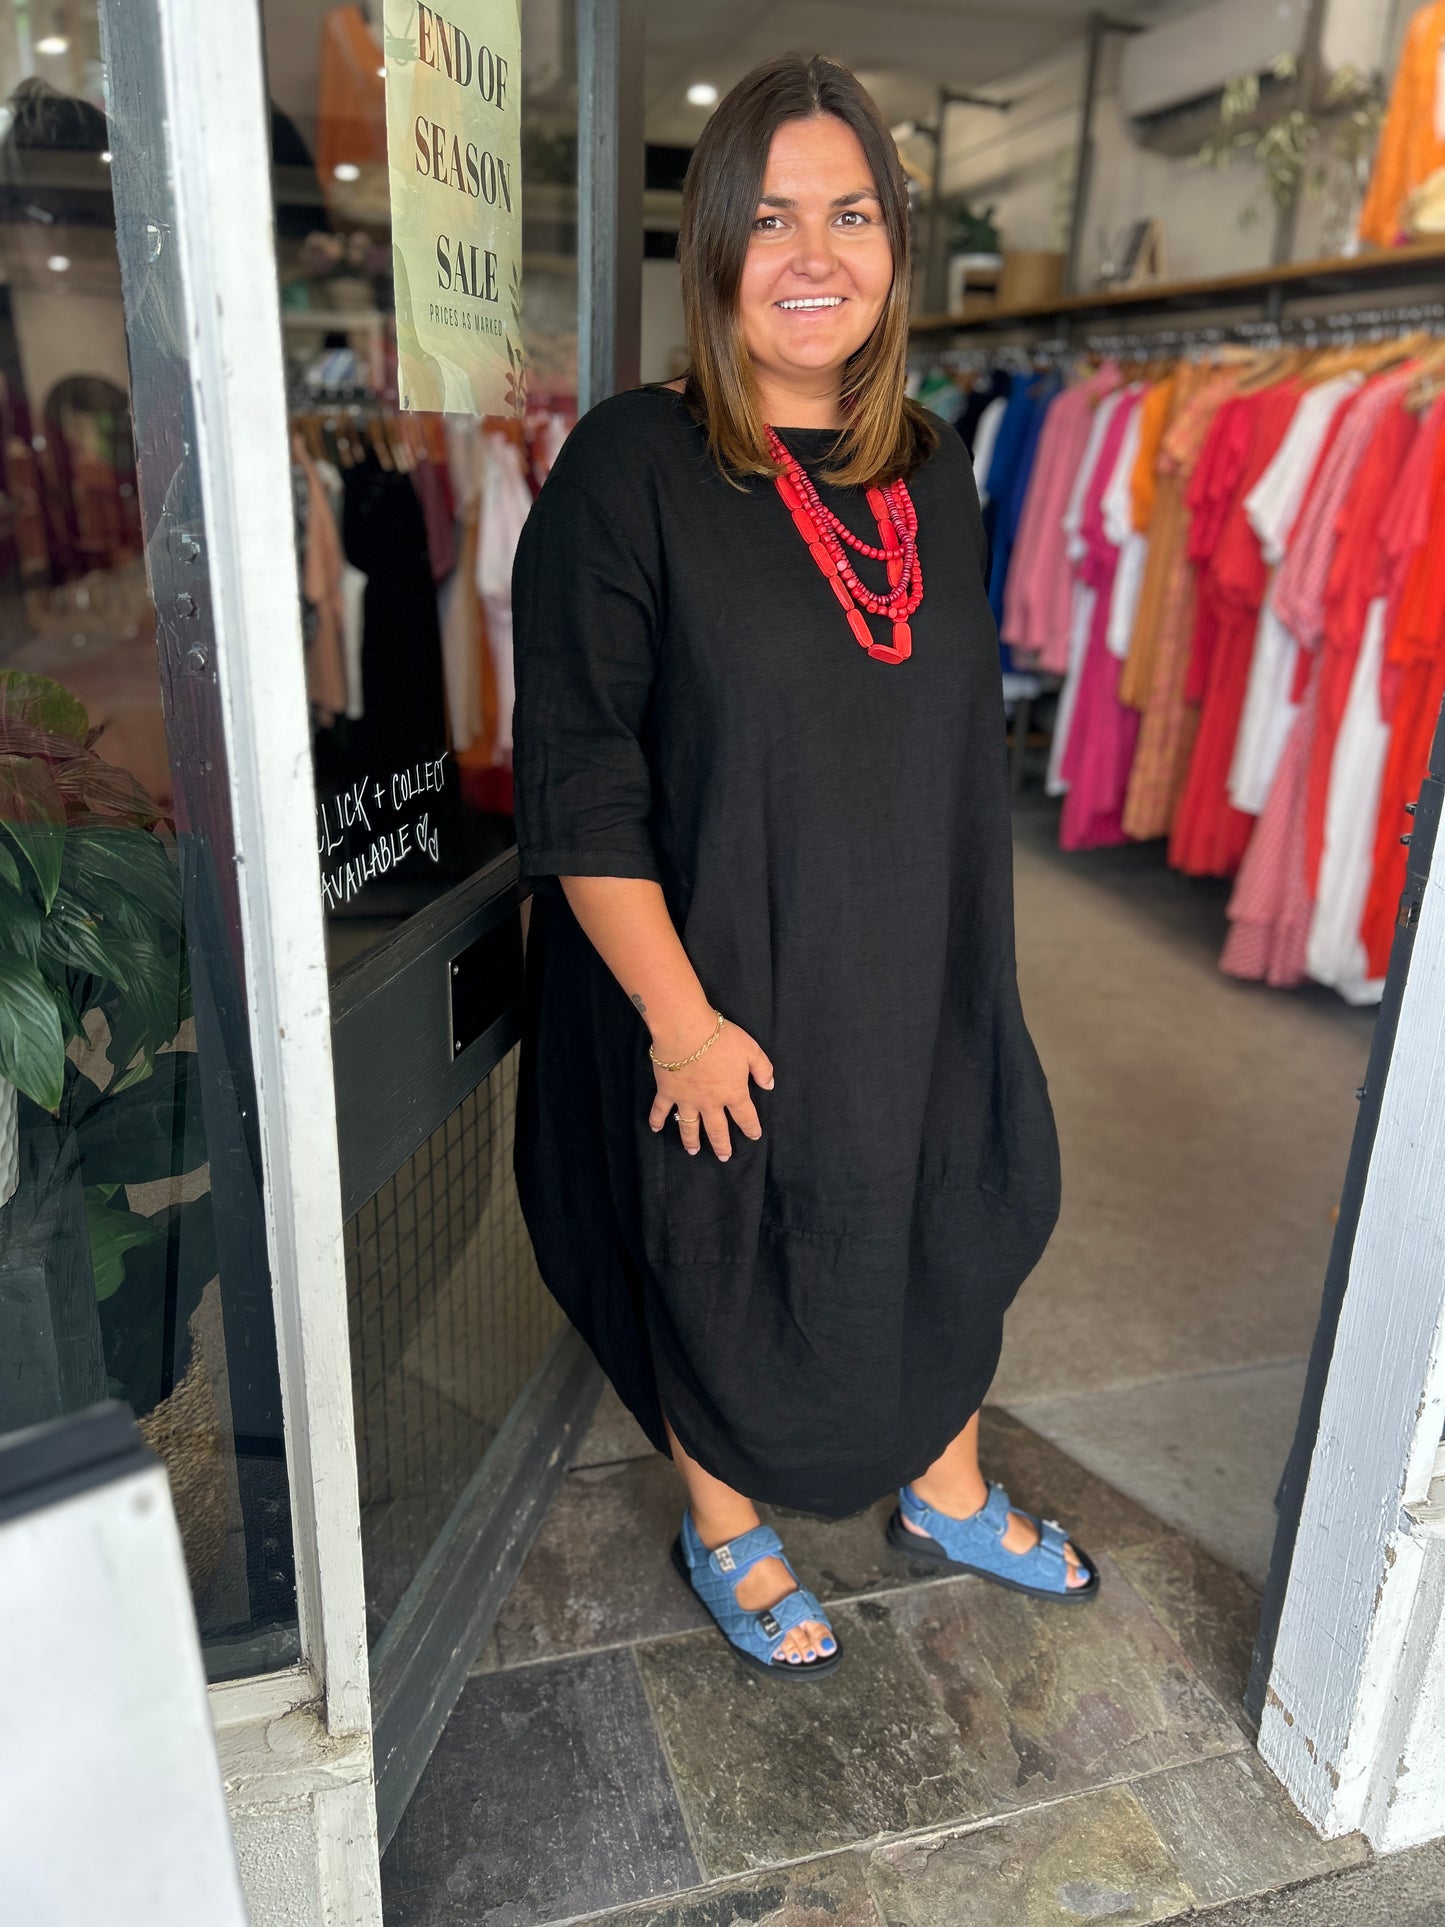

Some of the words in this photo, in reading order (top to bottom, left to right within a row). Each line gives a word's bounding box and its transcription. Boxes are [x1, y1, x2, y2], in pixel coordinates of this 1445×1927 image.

[416, 0, 473, 87] END
[478, 45, 508, 112] OF
[415, 115, 512, 213] SEASON
[436, 234, 499, 303] SALE
[429, 303, 459, 327] PRICES
[462, 311, 472, 330] AS
[474, 313, 503, 337] MARKED
[392, 751, 449, 811] COLLECT
[320, 823, 413, 911] AVAILABLE
